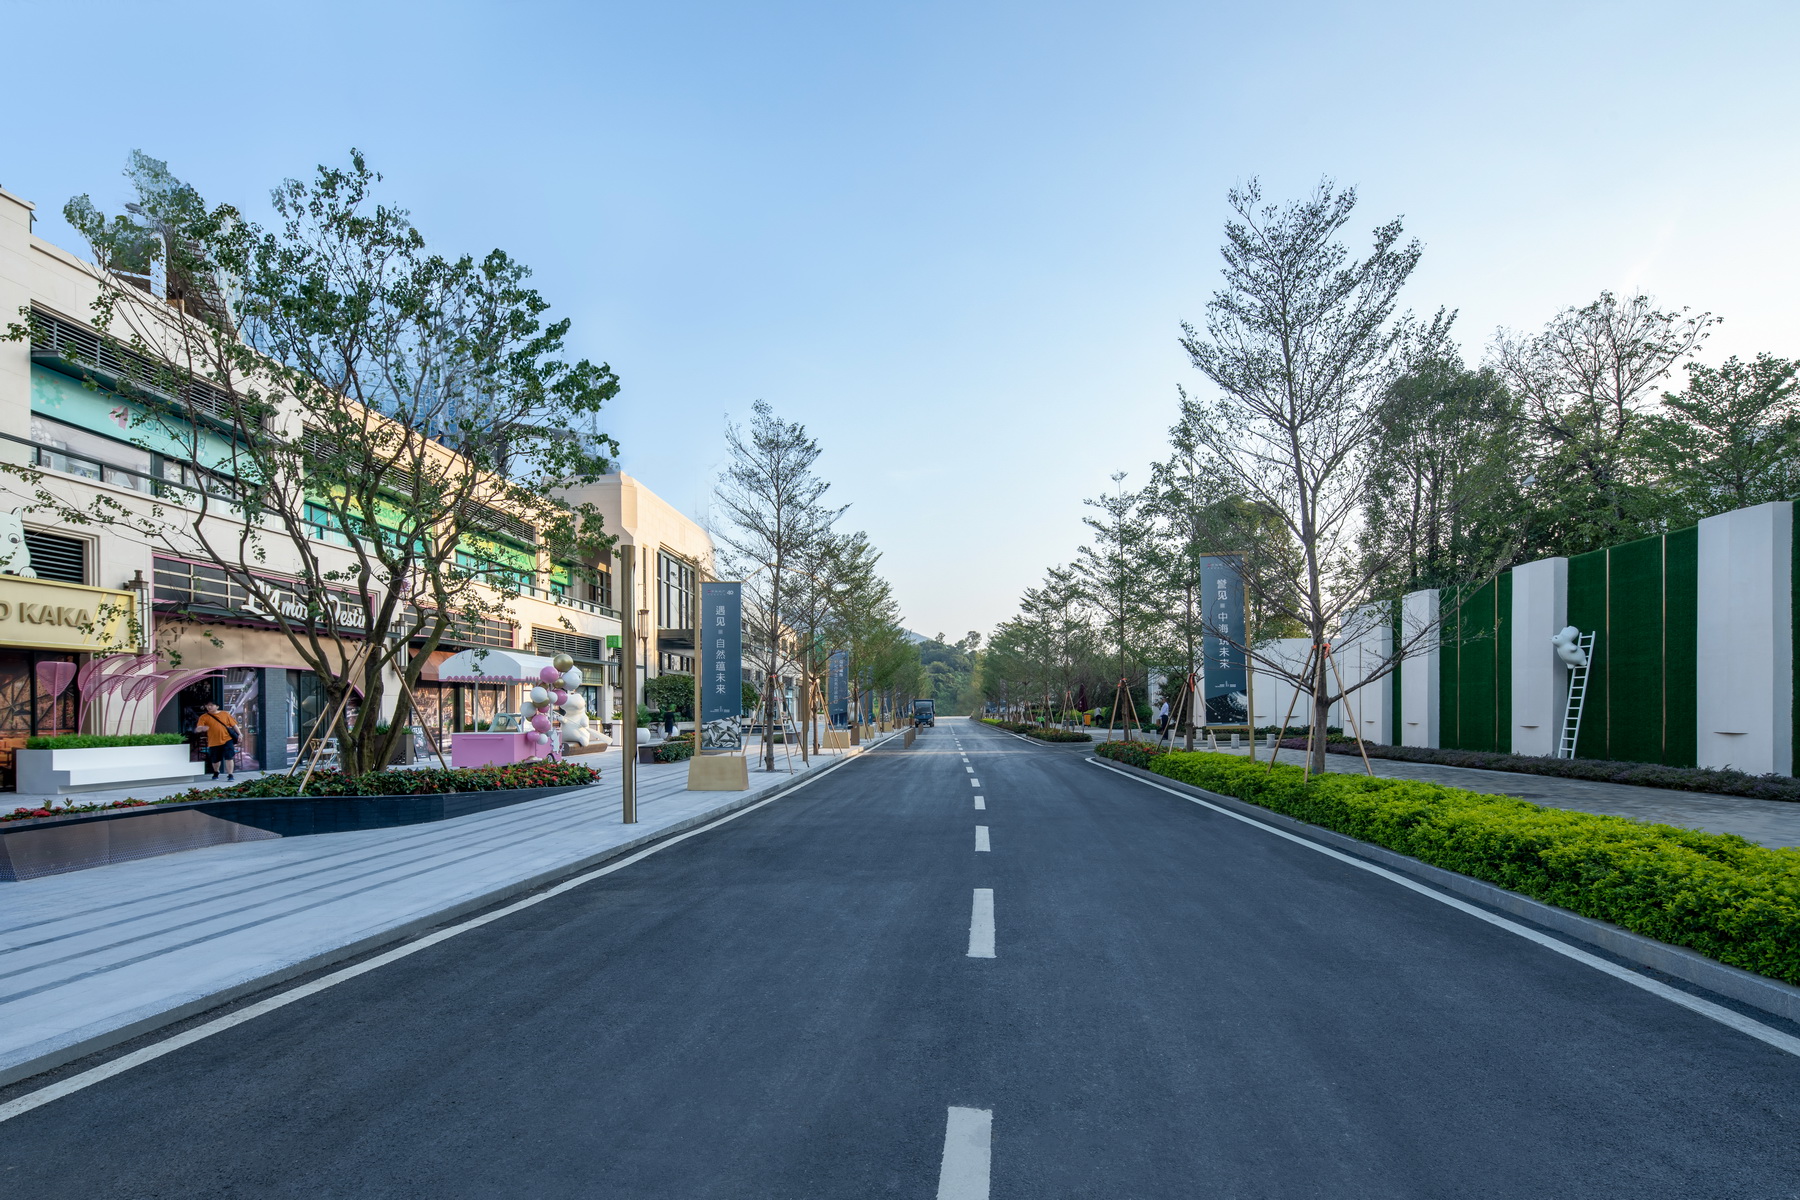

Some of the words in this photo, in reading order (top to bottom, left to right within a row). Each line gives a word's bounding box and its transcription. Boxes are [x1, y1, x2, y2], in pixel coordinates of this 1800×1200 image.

[19, 602, 92, 628] KAKA
[715, 605, 726, 627] 遇见
[715, 638, 726, 694] 自然蕴未来
